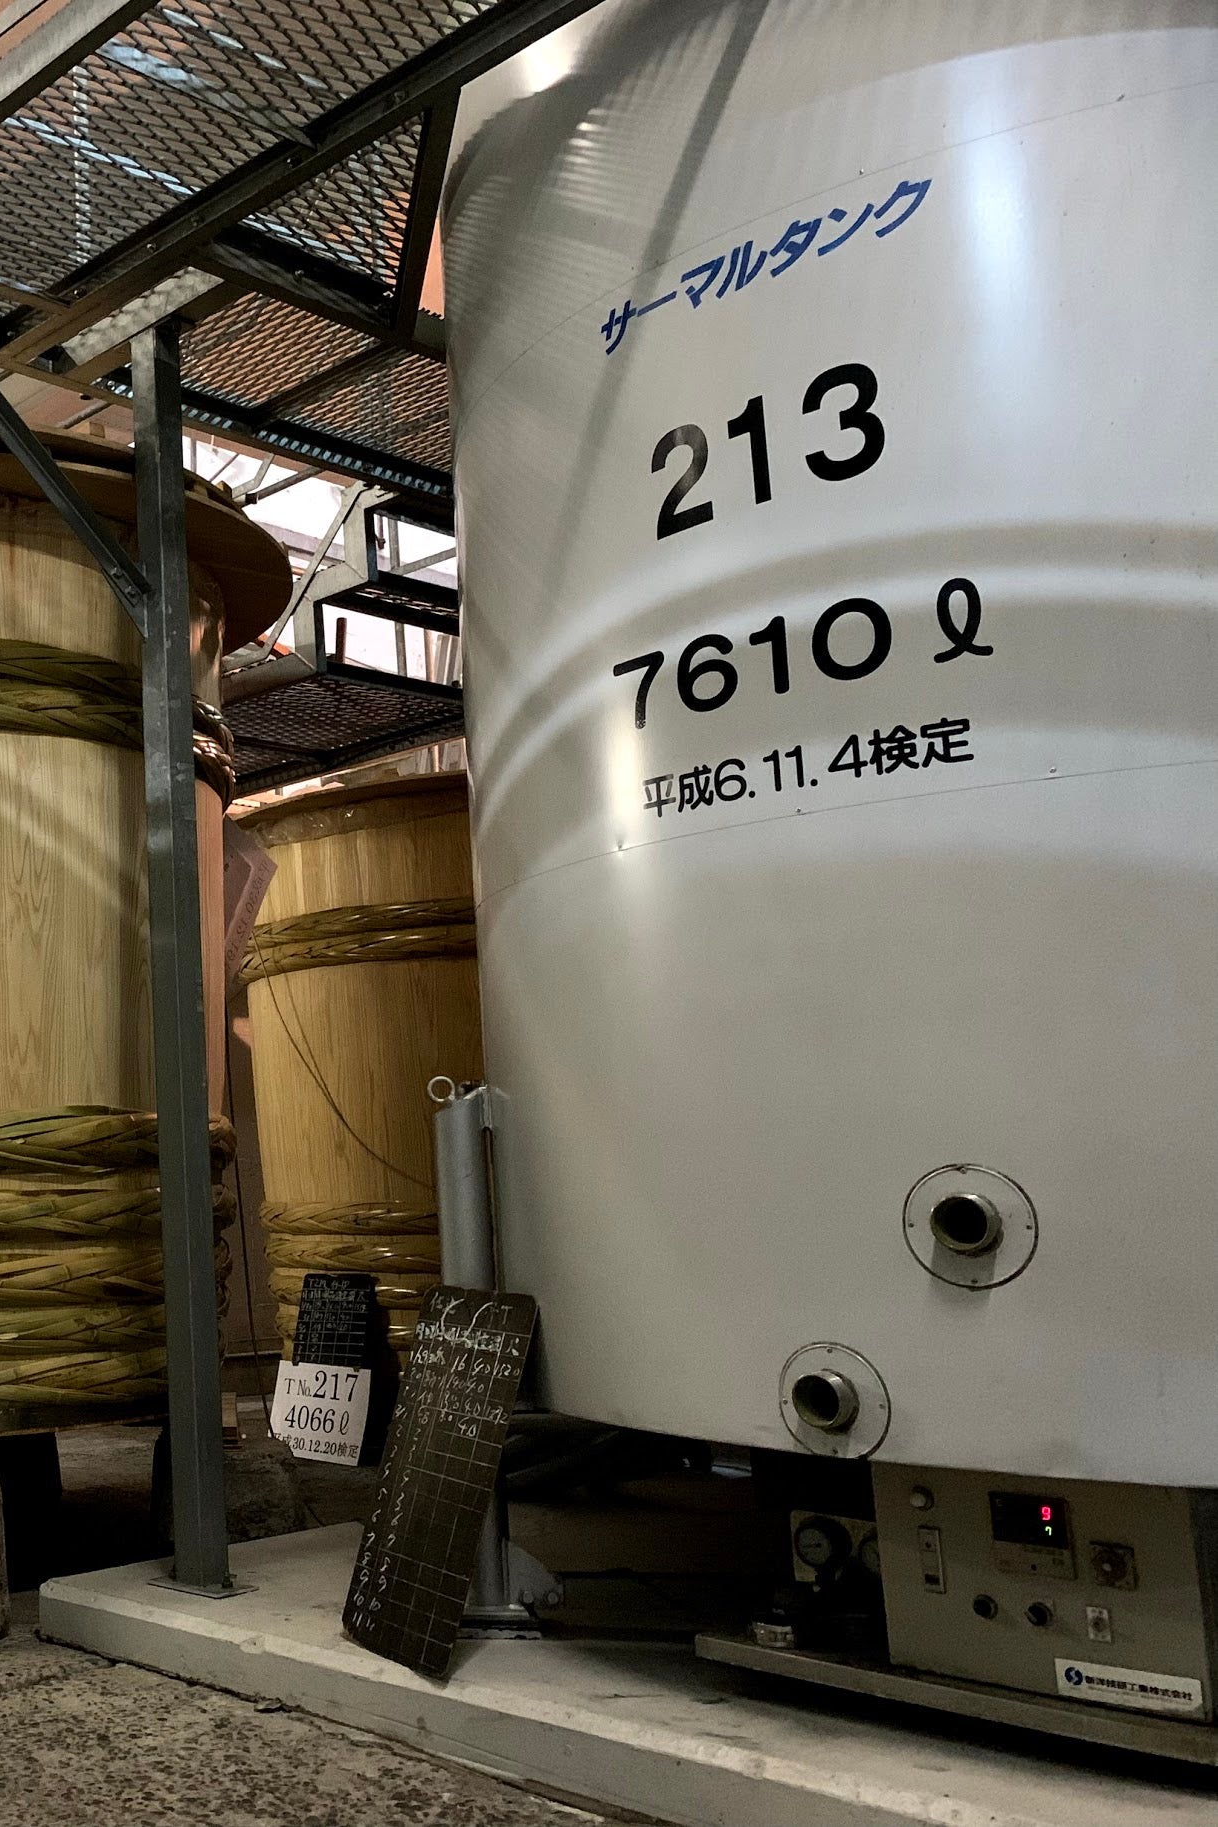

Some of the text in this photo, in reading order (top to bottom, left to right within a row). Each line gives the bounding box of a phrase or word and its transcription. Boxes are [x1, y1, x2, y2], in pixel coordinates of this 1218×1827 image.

[601, 179, 932, 356] サーマルタンク
[651, 363, 885, 540] 213
[613, 598, 892, 729] 7610
[1041, 1506, 1051, 1521] 9
[1045, 1525, 1052, 1536] 7
